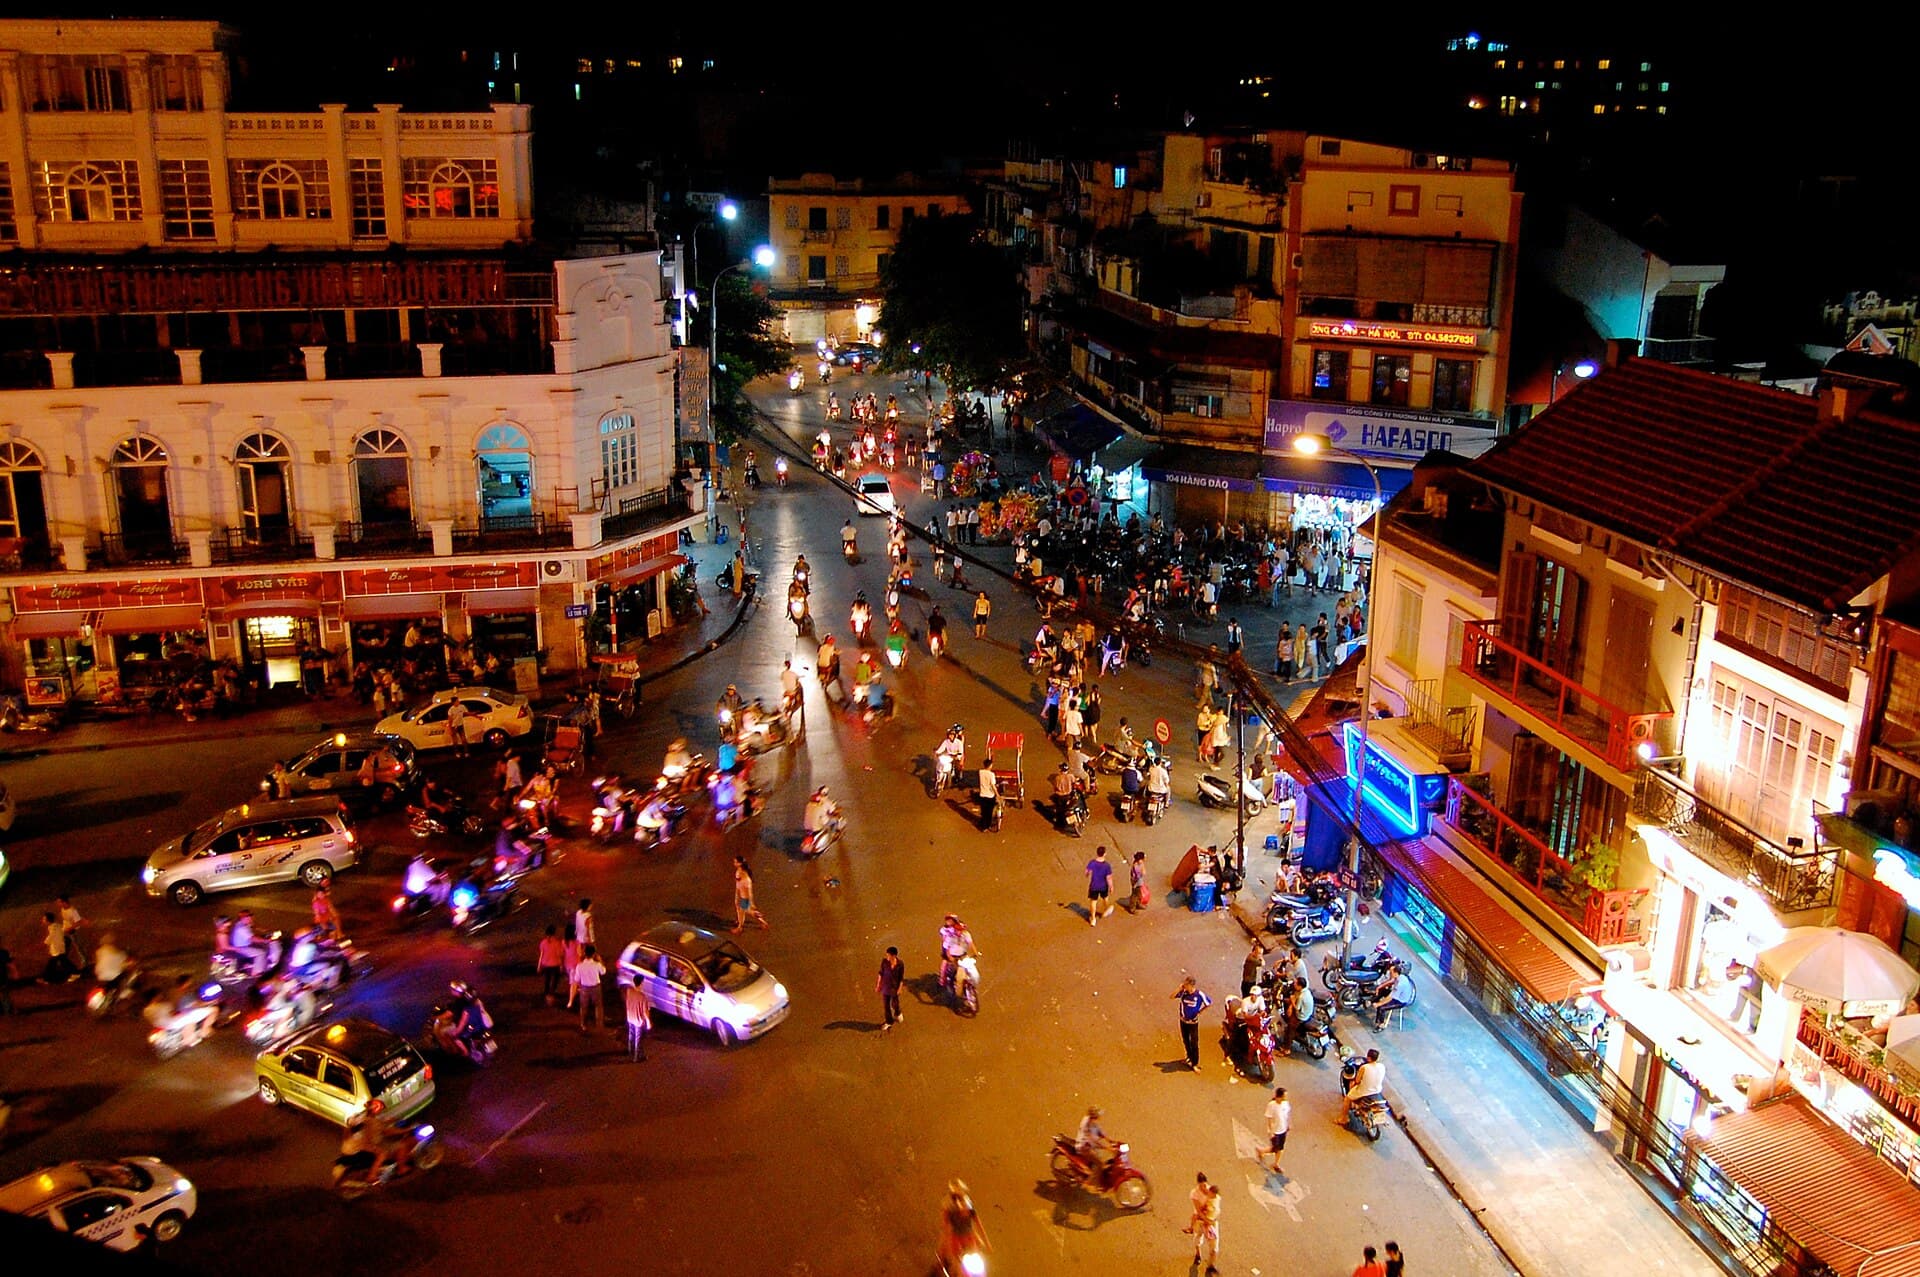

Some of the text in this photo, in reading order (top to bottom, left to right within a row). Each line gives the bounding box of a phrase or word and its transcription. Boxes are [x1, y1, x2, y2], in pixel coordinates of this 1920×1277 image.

[1266, 417, 1302, 436] Hapro
[1166, 474, 1180, 483] 104
[1180, 475, 1208, 487] HÀNG
[388, 572, 409, 582] Bar
[236, 579, 273, 590] LONG
